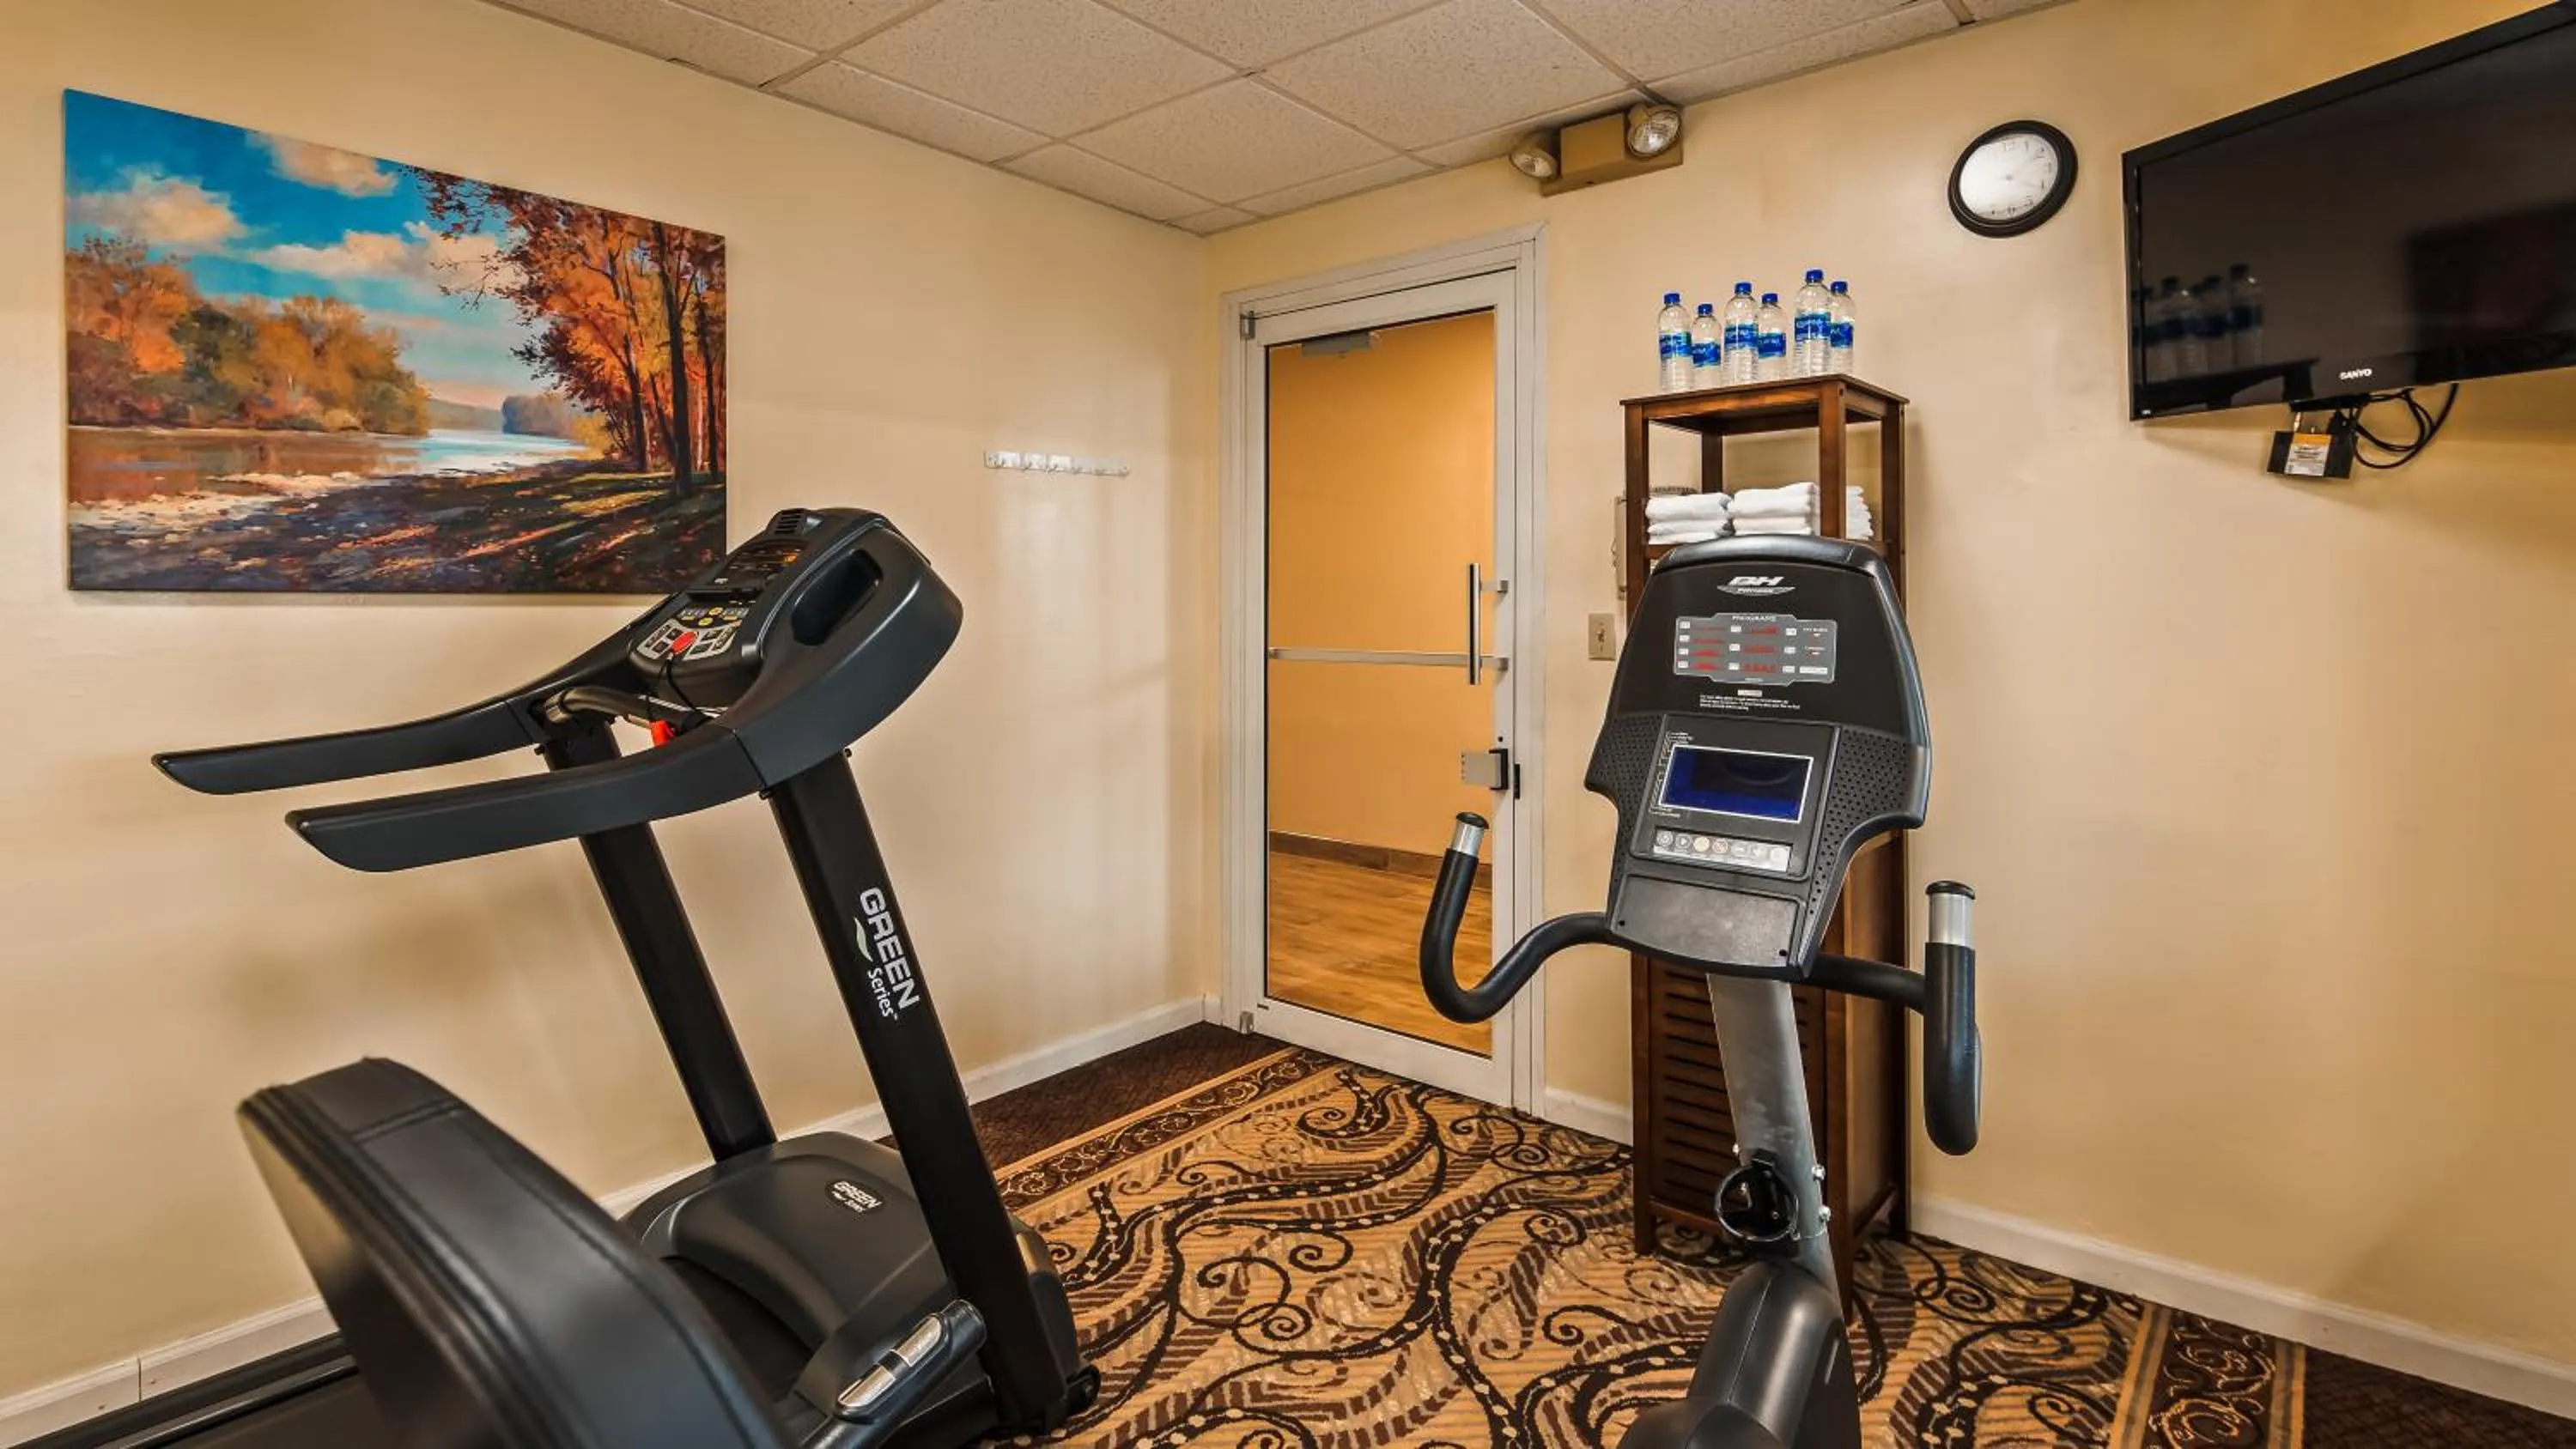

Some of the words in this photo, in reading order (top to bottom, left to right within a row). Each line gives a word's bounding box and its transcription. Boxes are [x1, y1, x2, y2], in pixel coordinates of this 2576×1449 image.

[2339, 368, 2372, 379] SANYO
[860, 886, 920, 1009] GREEN
[867, 967, 894, 1018] Series
